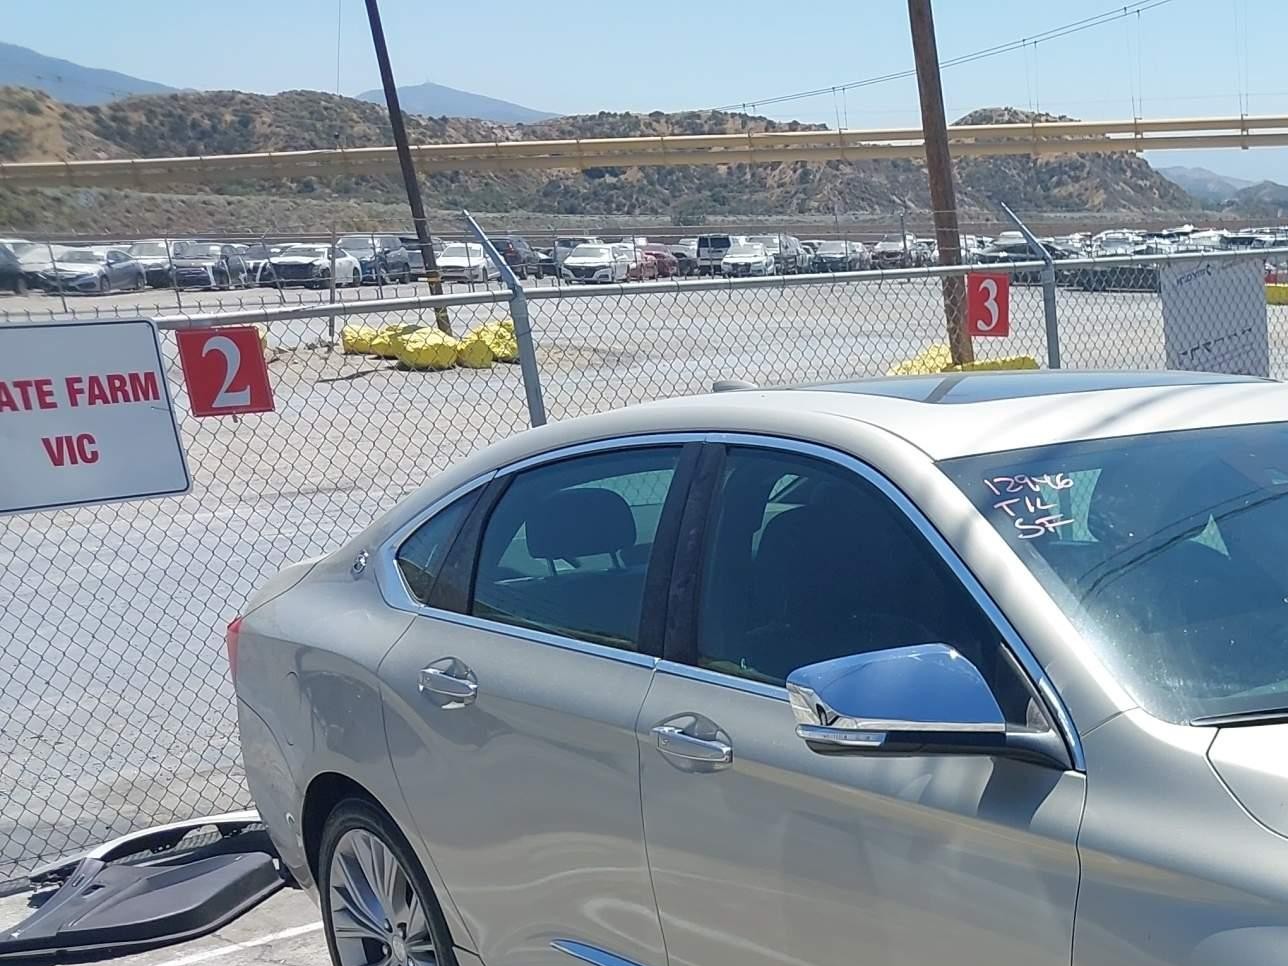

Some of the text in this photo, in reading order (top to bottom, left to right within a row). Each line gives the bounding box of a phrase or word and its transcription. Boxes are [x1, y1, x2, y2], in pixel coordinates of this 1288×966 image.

[977, 279, 1000, 332] 3
[65, 371, 160, 408] FARM
[201, 335, 251, 409] 2
[41, 433, 100, 467] VIC
[1014, 513, 1075, 539] SF
